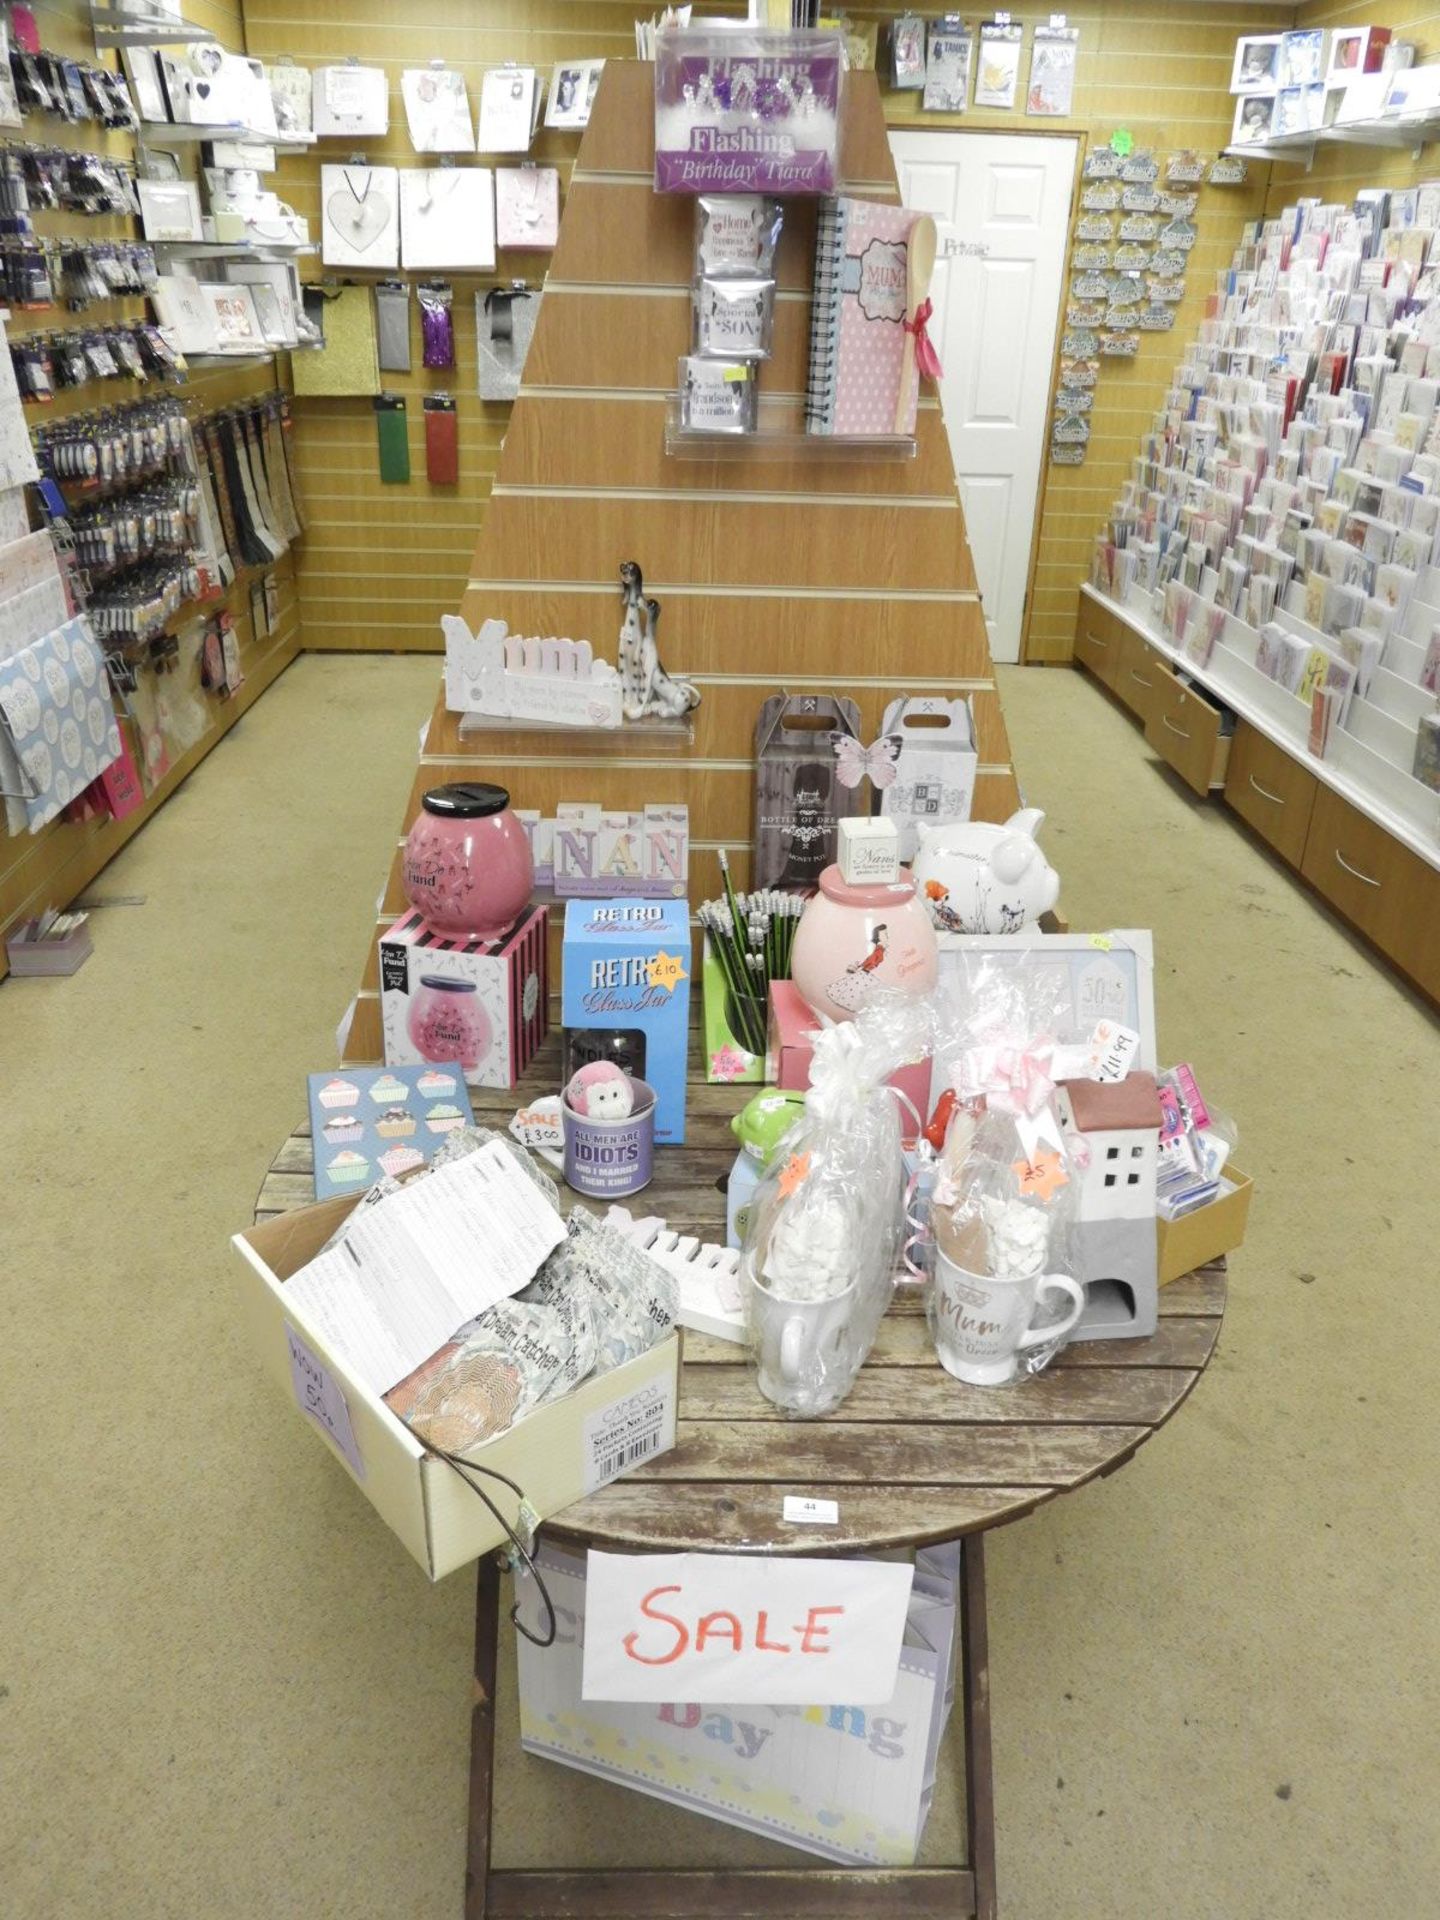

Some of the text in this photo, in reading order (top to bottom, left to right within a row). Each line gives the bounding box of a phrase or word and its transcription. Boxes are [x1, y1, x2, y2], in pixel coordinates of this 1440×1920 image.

[692, 126, 796, 158] Flashing
[766, 160, 813, 180] Tiara
[866, 265, 906, 289] MUM
[720, 320, 755, 336] SON
[761, 816, 838, 824] BOTTLE OF DRE
[788, 853, 811, 863] MONEY
[408, 870, 437, 889] Fund
[593, 906, 664, 922] RETRO
[383, 956, 406, 967] Fund
[655, 965, 677, 976] £10
[583, 987, 673, 1014] Glass Jar
[435, 1031, 461, 1042] Fund
[518, 1108, 559, 1127] SALE
[575, 1130, 639, 1145] ALL MEN ARE
[575, 1142, 639, 1164] IDIOTS
[575, 1164, 592, 1175] AND
[598, 1164, 639, 1177] MARRIED
[581, 1175, 605, 1187] THEIR
[940, 1291, 1001, 1337] Mum
[482, 1309, 518, 1347] Dream
[516, 1333, 560, 1372] Catcher
[593, 1427, 625, 1446] Series
[622, 1585, 845, 1665] SALE
